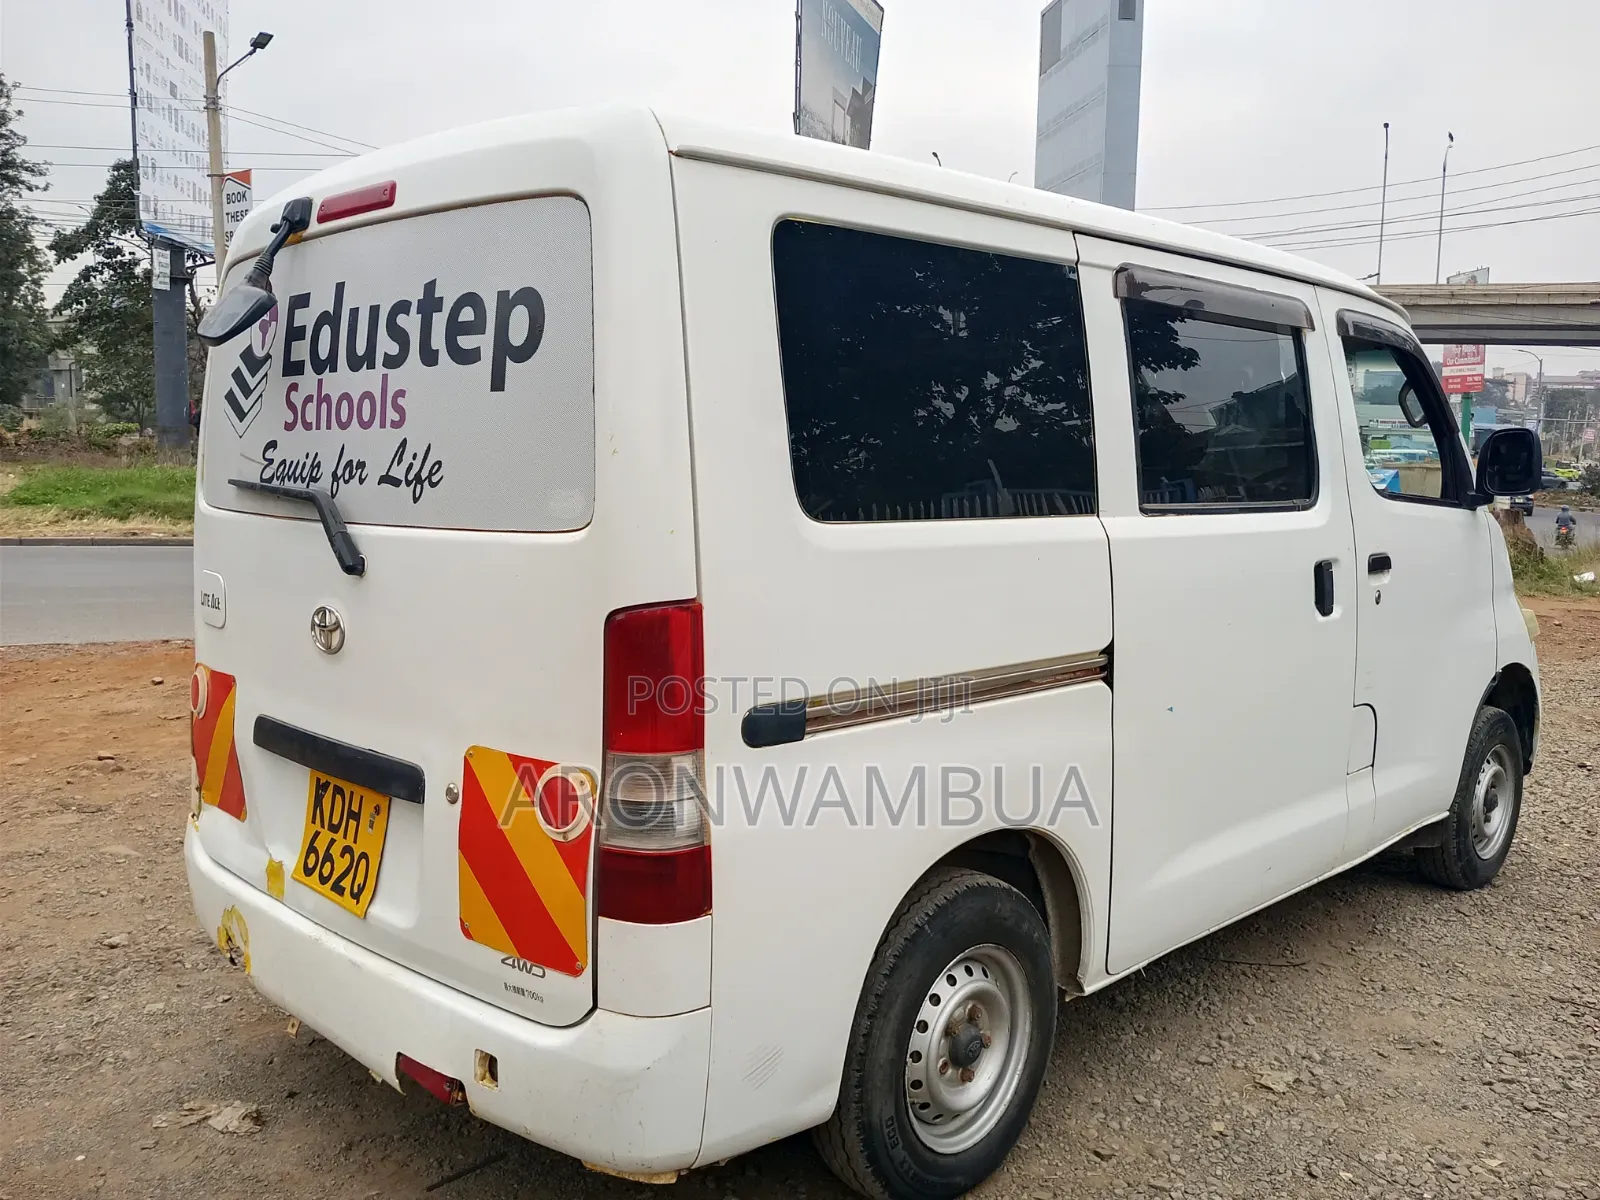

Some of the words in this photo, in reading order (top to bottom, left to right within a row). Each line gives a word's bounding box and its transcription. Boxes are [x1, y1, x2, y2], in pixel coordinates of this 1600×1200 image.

[820, 0, 862, 73] NOUVEAU
[226, 190, 247, 205] BOOK
[282, 278, 545, 392] Edustep
[283, 373, 407, 432] Schools
[259, 439, 323, 490] Equip
[330, 443, 368, 499] for
[377, 437, 444, 504] Life
[311, 776, 364, 844] KDH
[302, 829, 370, 906] 662Q
[500, 955, 546, 979] 4WD
